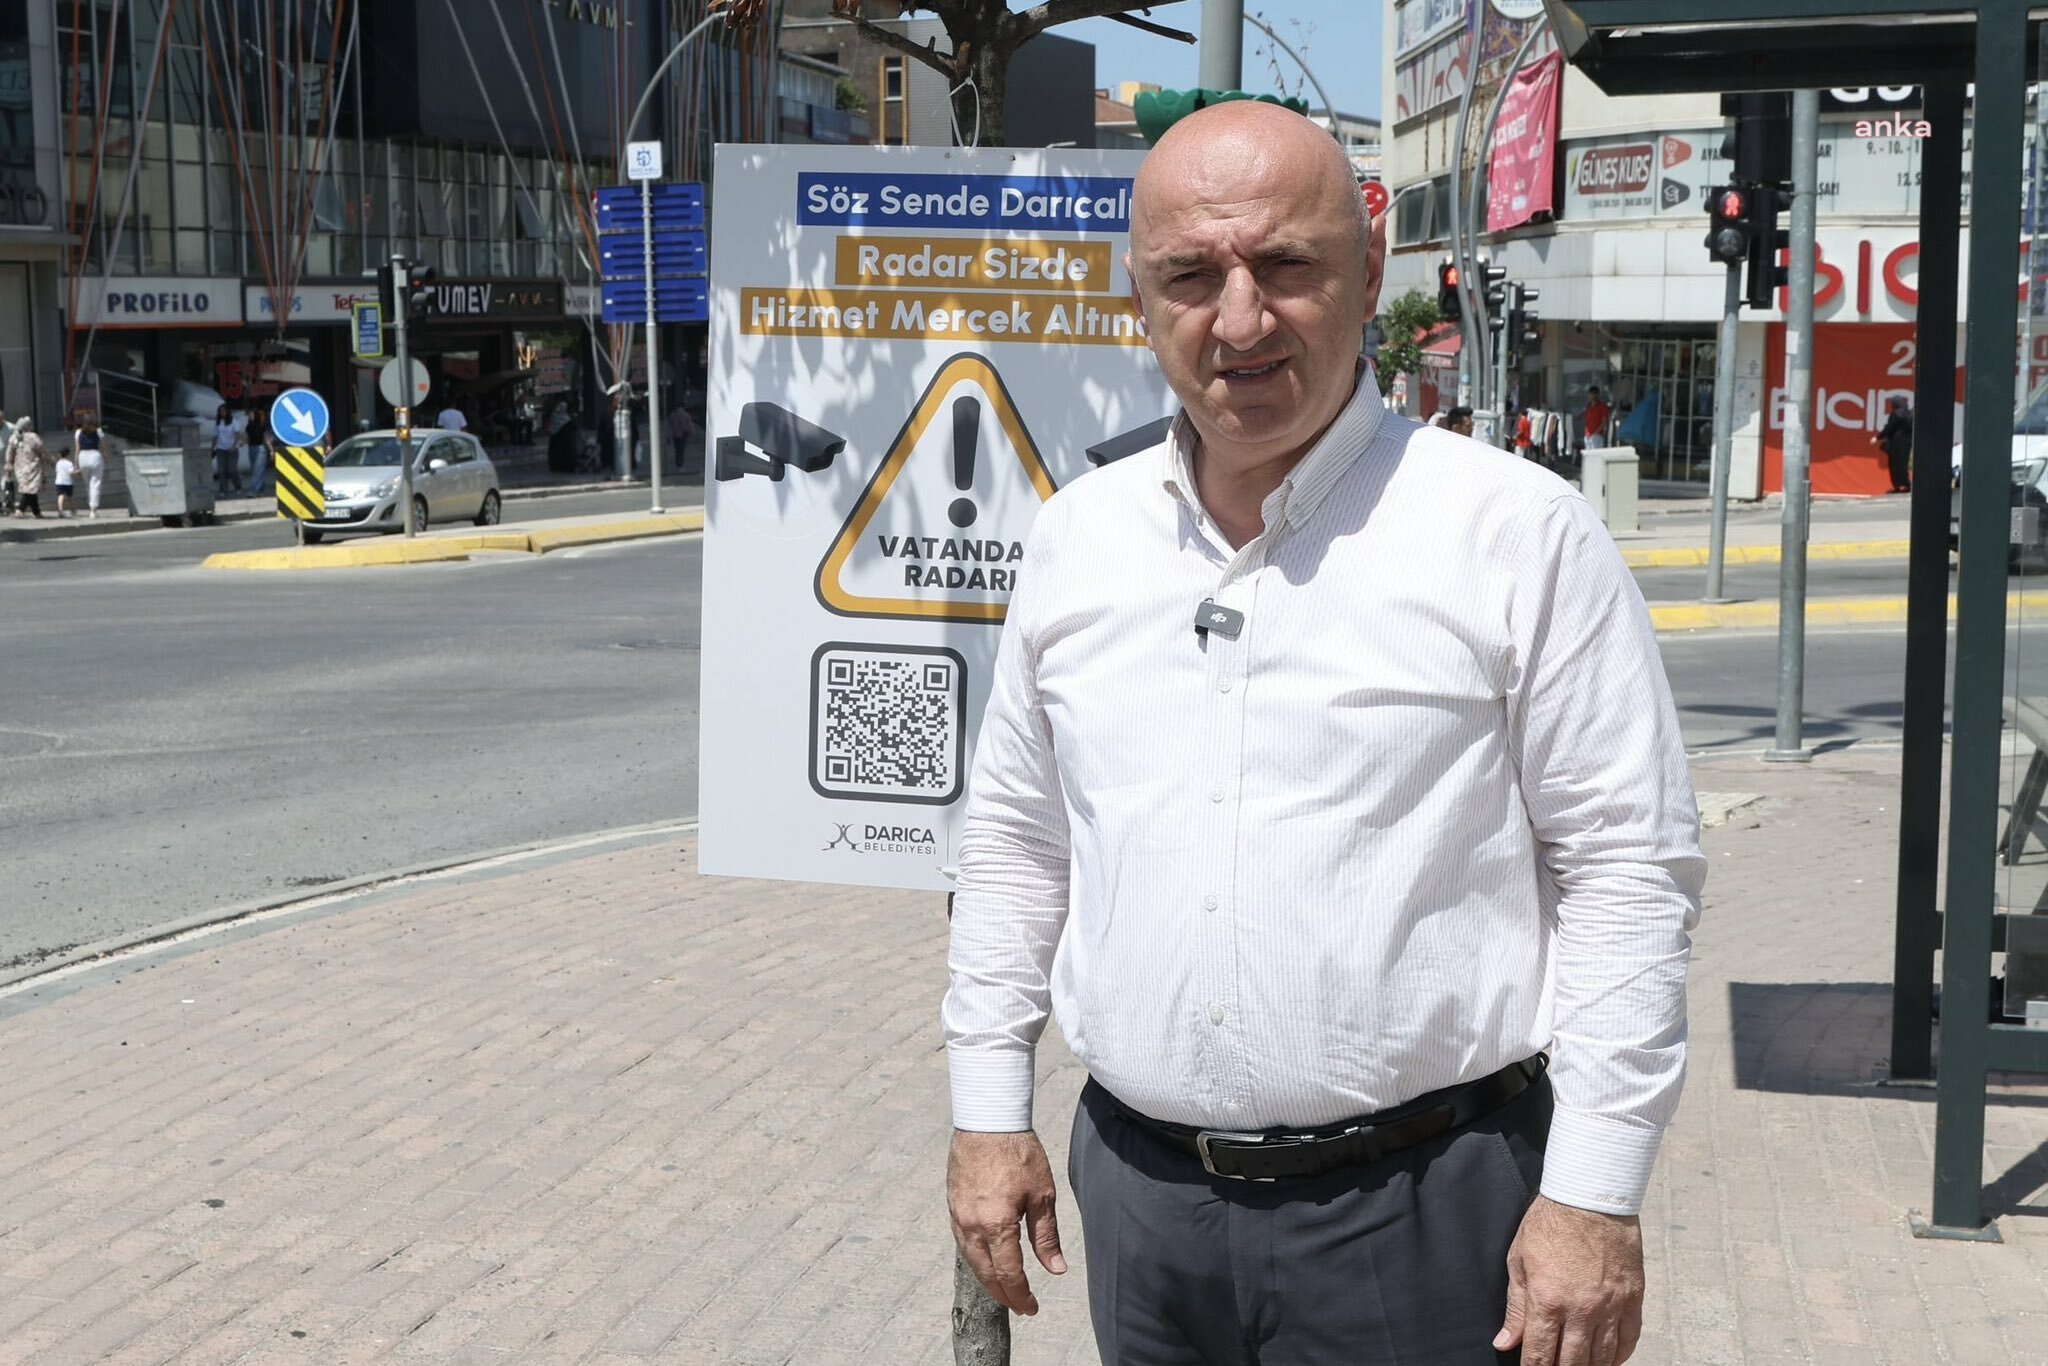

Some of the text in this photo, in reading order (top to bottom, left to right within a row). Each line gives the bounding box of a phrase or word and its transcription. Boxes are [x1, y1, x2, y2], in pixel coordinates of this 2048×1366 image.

[1580, 153, 1650, 189] GÜNEŞ KURS
[807, 182, 869, 215] Söz
[880, 186, 990, 218] Sende
[858, 245, 1088, 281] Radar Sizde
[751, 296, 879, 330] Hizmet
[891, 300, 1032, 334] Mercek
[878, 535, 1024, 563] VATANDA
[904, 564, 1016, 591] RADARI
[864, 824, 936, 845] DARICA
[864, 841, 937, 856] BELEDİYESİ
